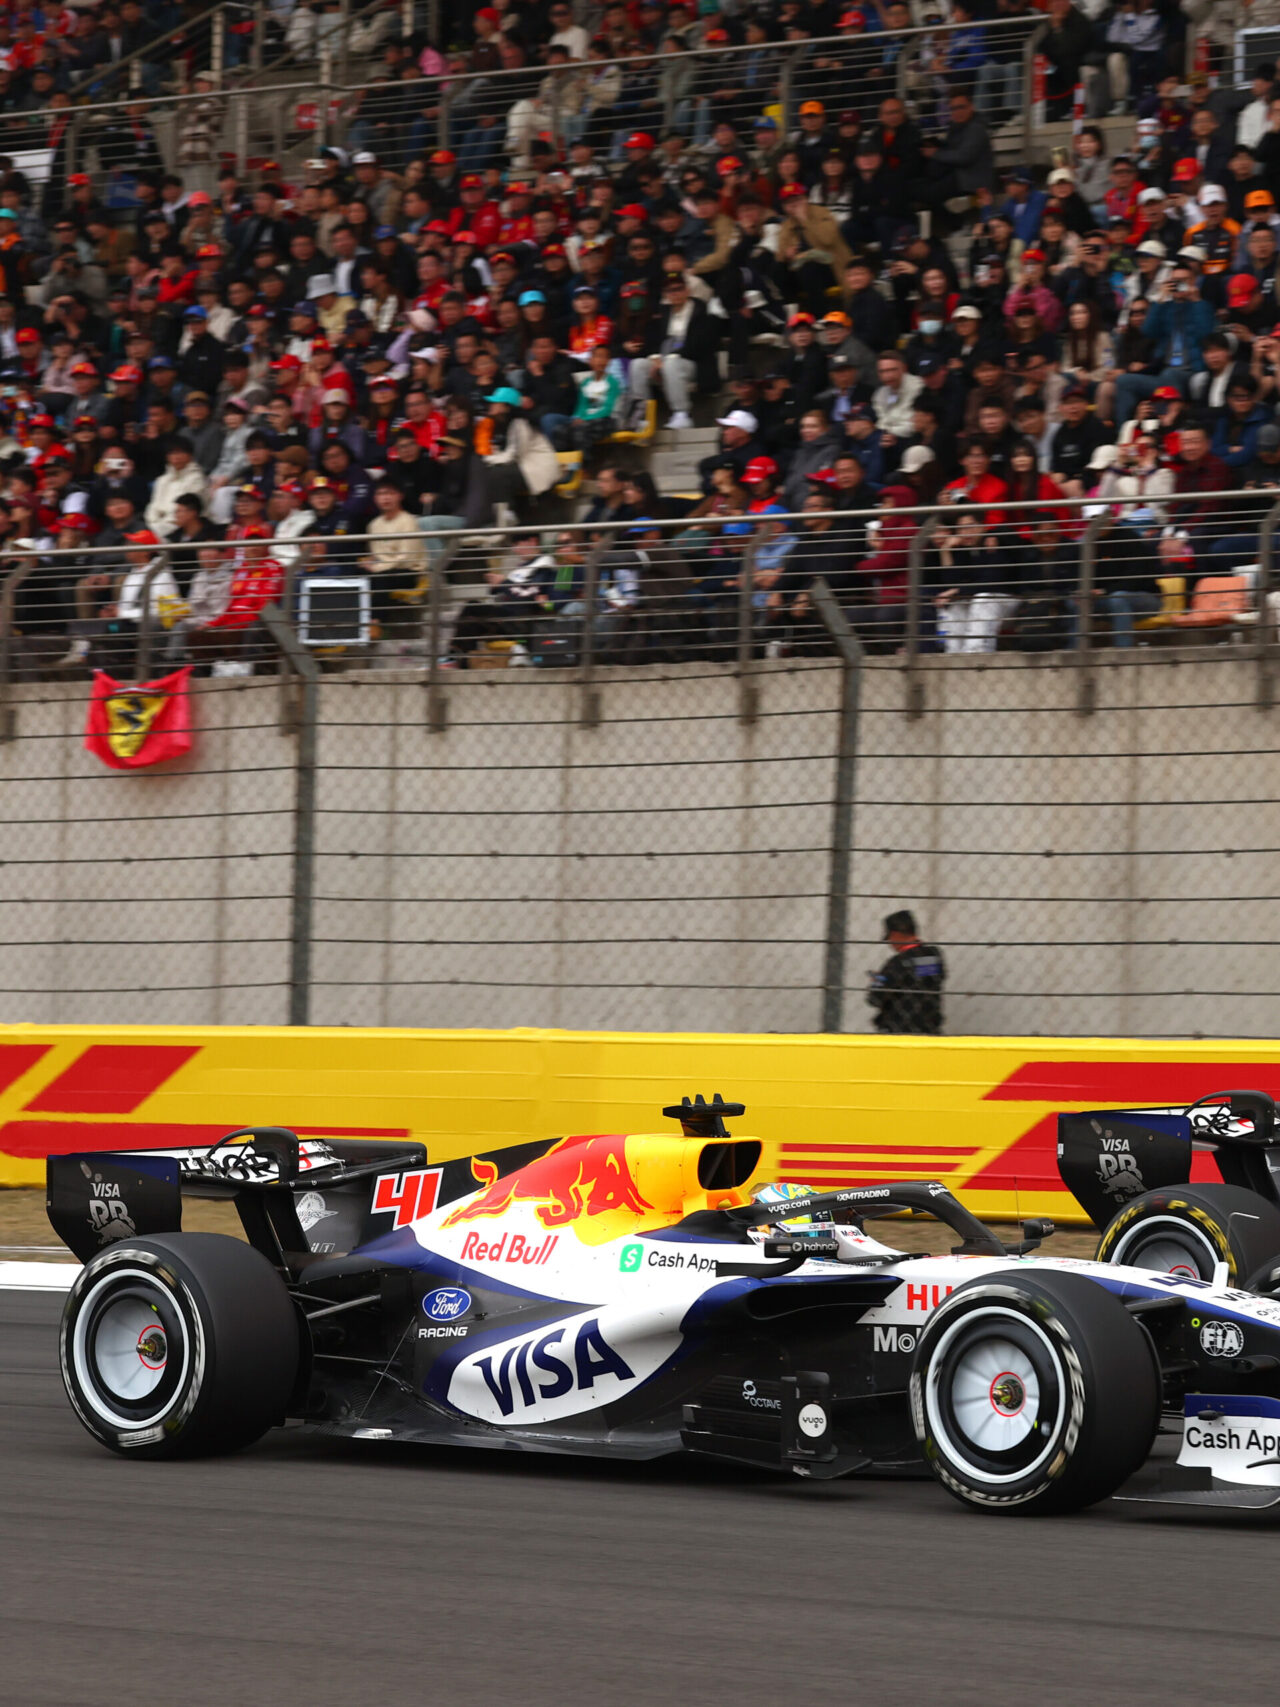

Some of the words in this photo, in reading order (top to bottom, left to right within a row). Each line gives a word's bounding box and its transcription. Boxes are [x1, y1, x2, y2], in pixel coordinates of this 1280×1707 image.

[1100, 1138, 1130, 1151] VISA
[90, 1183, 121, 1197] VISA
[371, 1168, 444, 1231] 41
[768, 1199, 811, 1215] yugo.com
[461, 1231, 507, 1262] Red
[506, 1235, 559, 1265] Bull
[648, 1251, 684, 1268] Cash
[687, 1253, 719, 1273] App
[431, 1290, 464, 1317] Ford
[907, 1283, 953, 1311] HU
[418, 1326, 469, 1339] RACING
[472, 1318, 636, 1417] VISA
[750, 1397, 782, 1410] OCTAVE
[802, 1417, 824, 1428] yugo
[1186, 1426, 1240, 1450] Cash
